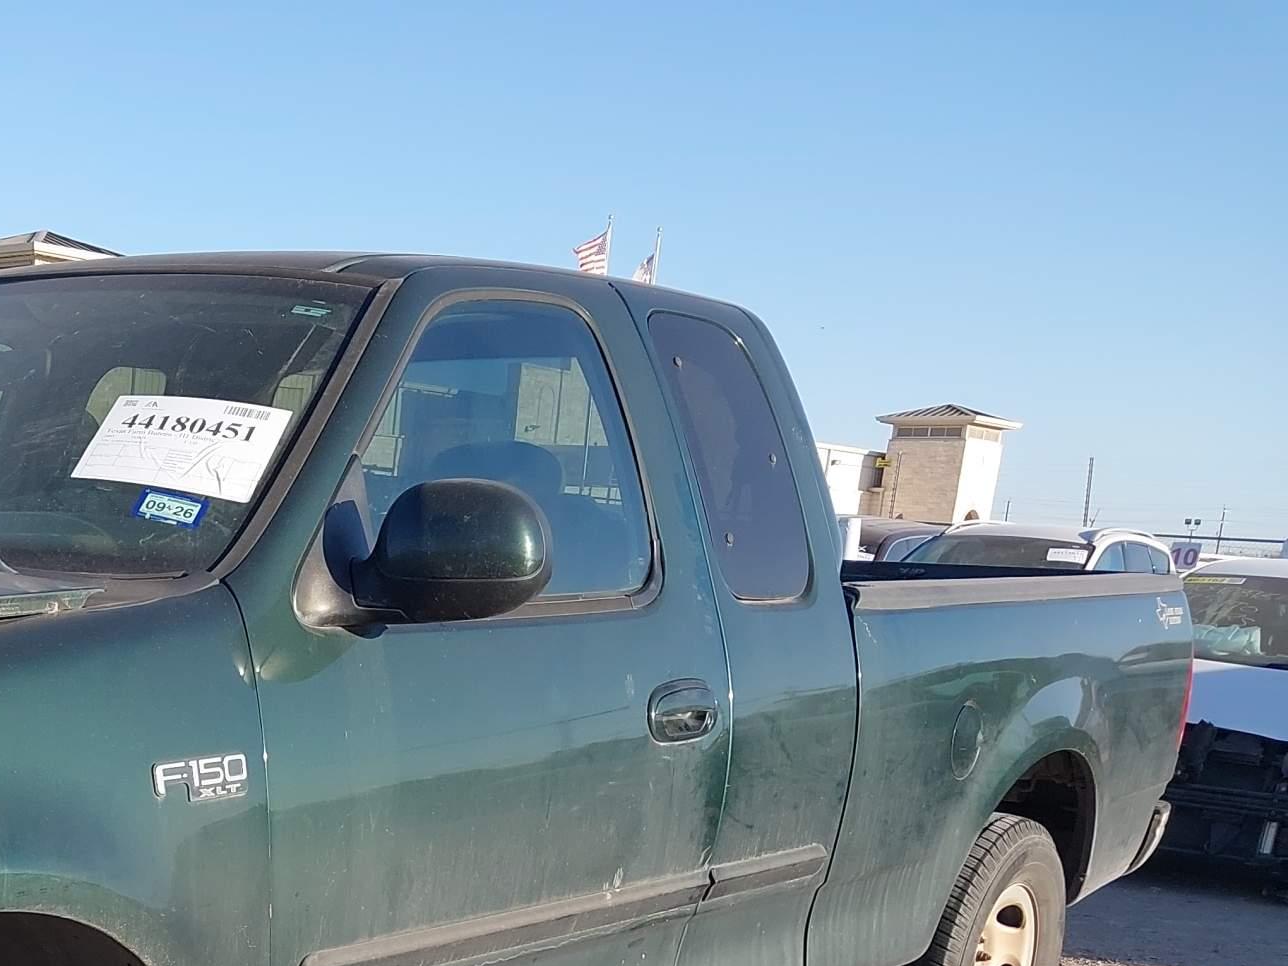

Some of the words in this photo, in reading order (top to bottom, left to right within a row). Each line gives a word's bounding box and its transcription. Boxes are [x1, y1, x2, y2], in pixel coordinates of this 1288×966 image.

[121, 413, 256, 442] 44180451
[145, 499, 167, 512] 09
[172, 505, 194, 519] 26
[1172, 547, 1198, 566] 10
[199, 783, 242, 798] XLT
